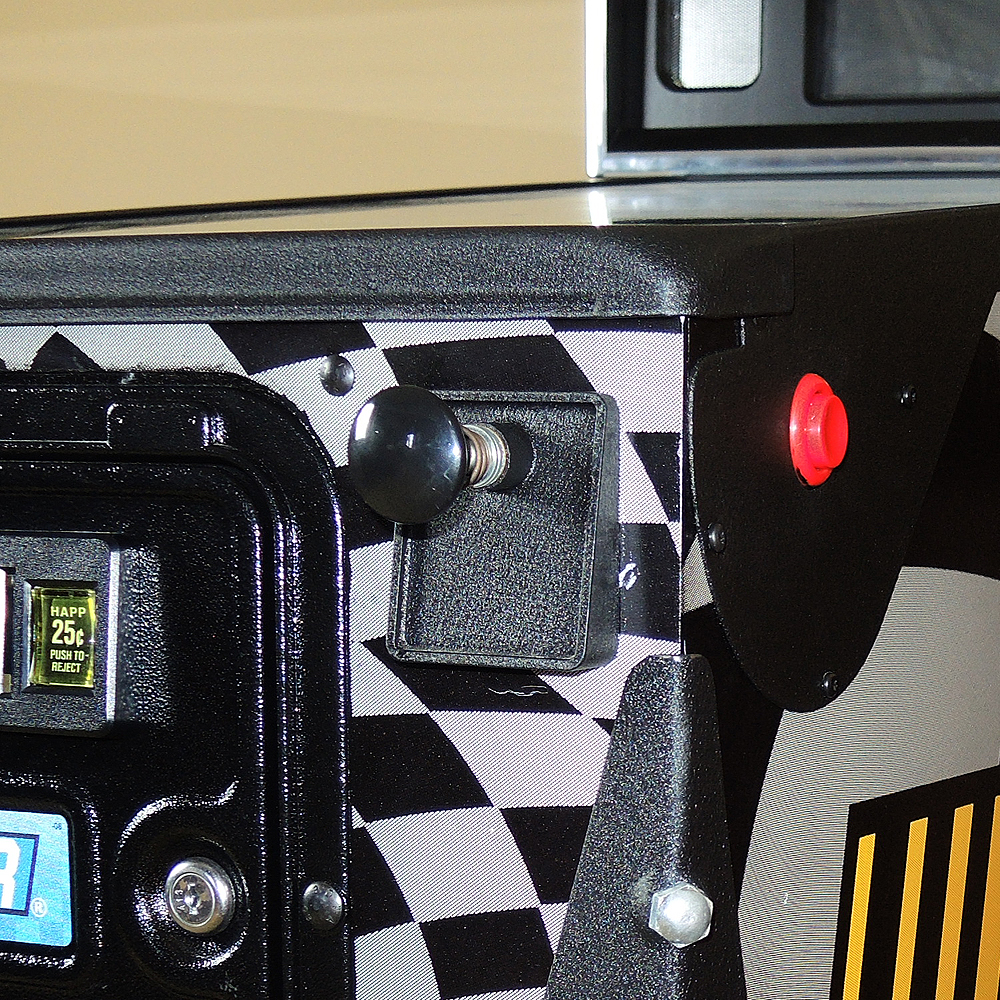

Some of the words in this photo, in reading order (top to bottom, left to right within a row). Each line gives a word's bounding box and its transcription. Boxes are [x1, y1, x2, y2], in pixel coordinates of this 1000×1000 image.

[50, 606, 87, 618] HAPP
[51, 618, 85, 648] 25¢
[49, 649, 73, 660] PUSH
[51, 661, 82, 673] REJECT
